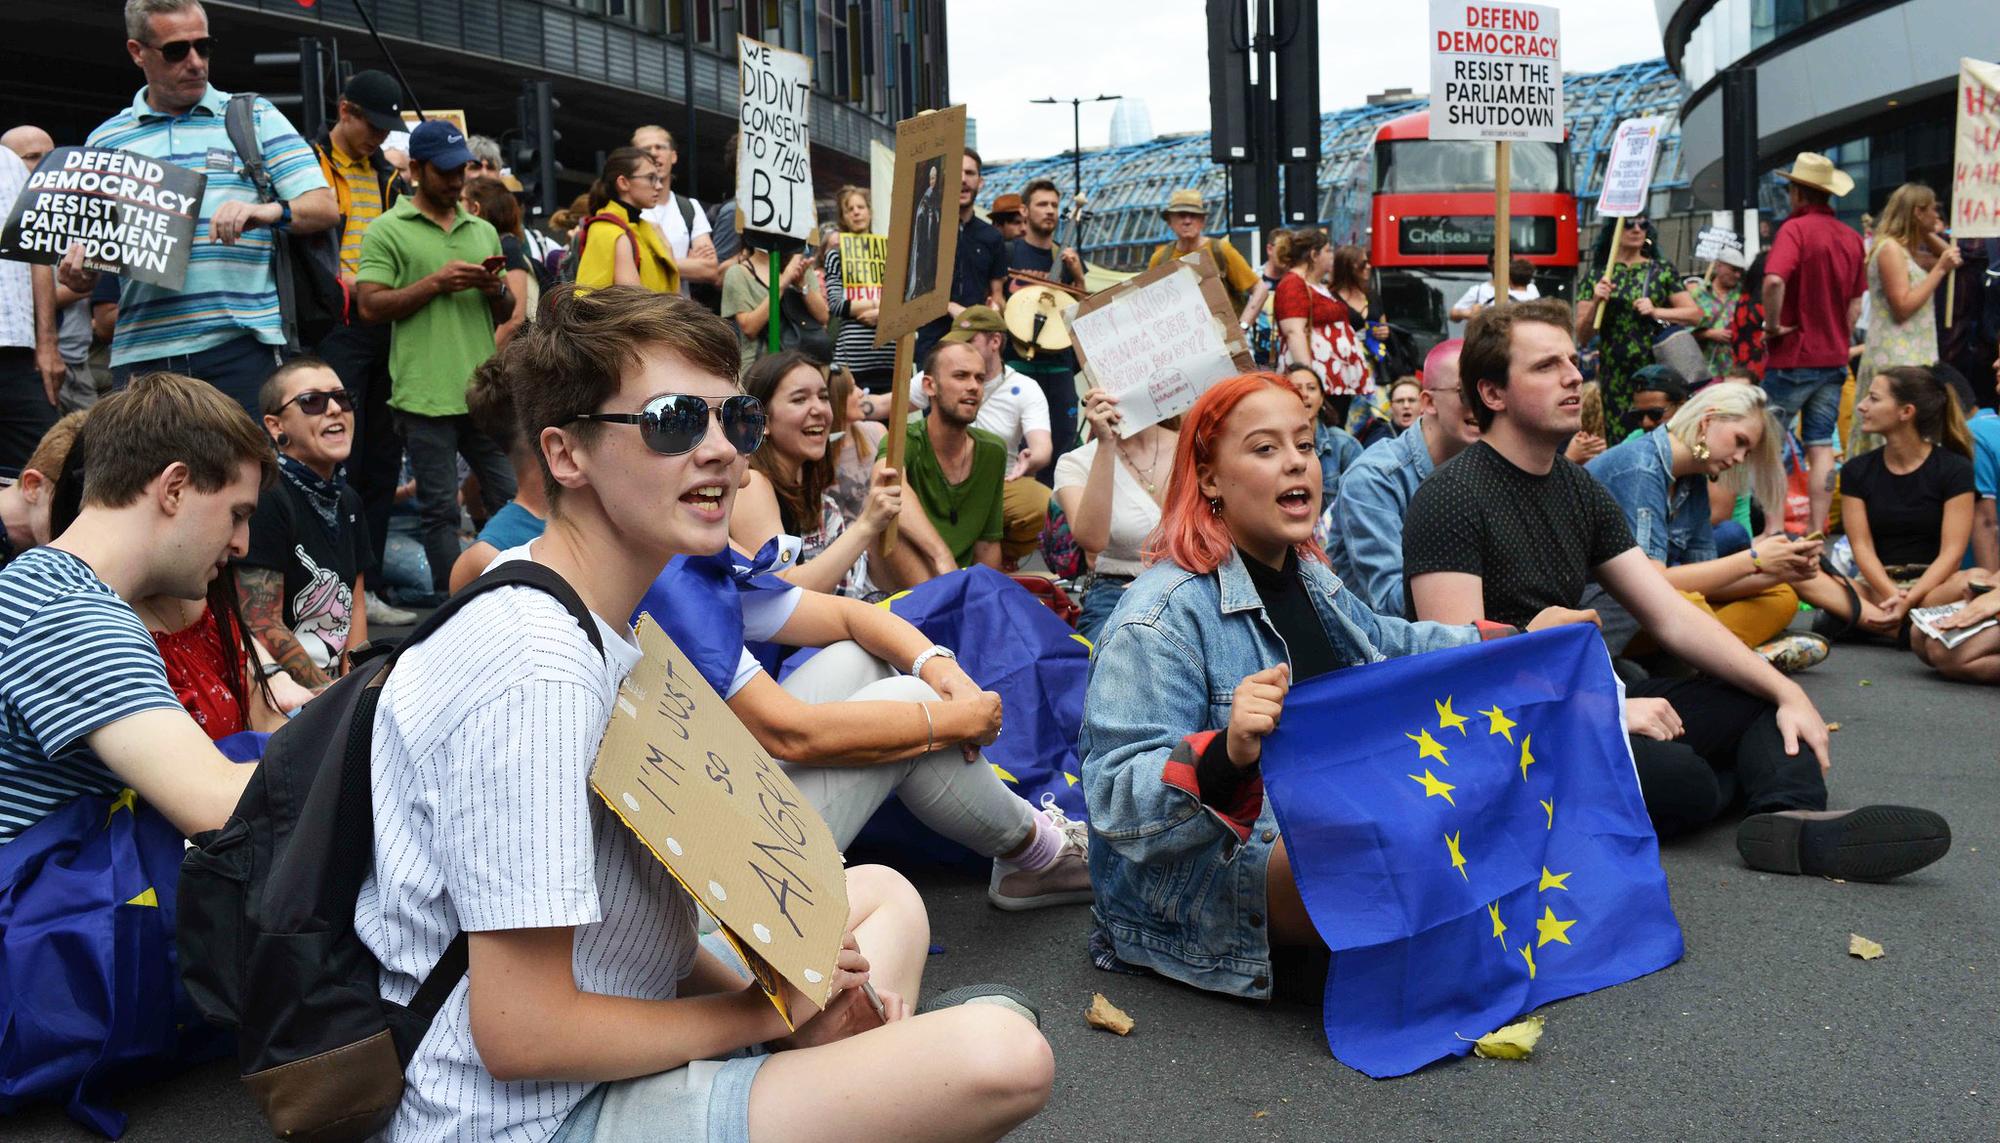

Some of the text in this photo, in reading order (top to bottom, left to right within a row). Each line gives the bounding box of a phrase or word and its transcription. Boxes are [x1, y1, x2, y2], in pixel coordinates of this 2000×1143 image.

[1466, 6, 1539, 31] DEFEND
[743, 40, 771, 66] WE
[1437, 30, 1557, 58] DEMOCRACY
[1455, 60, 1549, 84] RESIST THE
[743, 61, 809, 117] DIDN'T
[1446, 82, 1555, 106] PARLIAMENT
[742, 102, 809, 147] CONSENT
[1448, 105, 1553, 127] SHUTDOWN
[63, 151, 164, 184] DEFEND
[744, 131, 808, 183] TO THIS
[28, 170, 196, 215] DEMOCRACY
[751, 168, 799, 233] BJ
[35, 192, 170, 234] RESIST THE
[20, 210, 178, 254] PARLIAMENT
[844, 236, 888, 261] REMAI
[1408, 228, 1471, 244] Chelsea
[1520, 227, 1535, 248] 11
[846, 260, 886, 285] REFOR
[1128, 279, 1182, 325] KIDS
[1153, 311, 1190, 343] SEE
[637, 659, 696, 816] I'M JUST
[704, 751, 734, 797] SO
[748, 751, 815, 939] ANGRY
